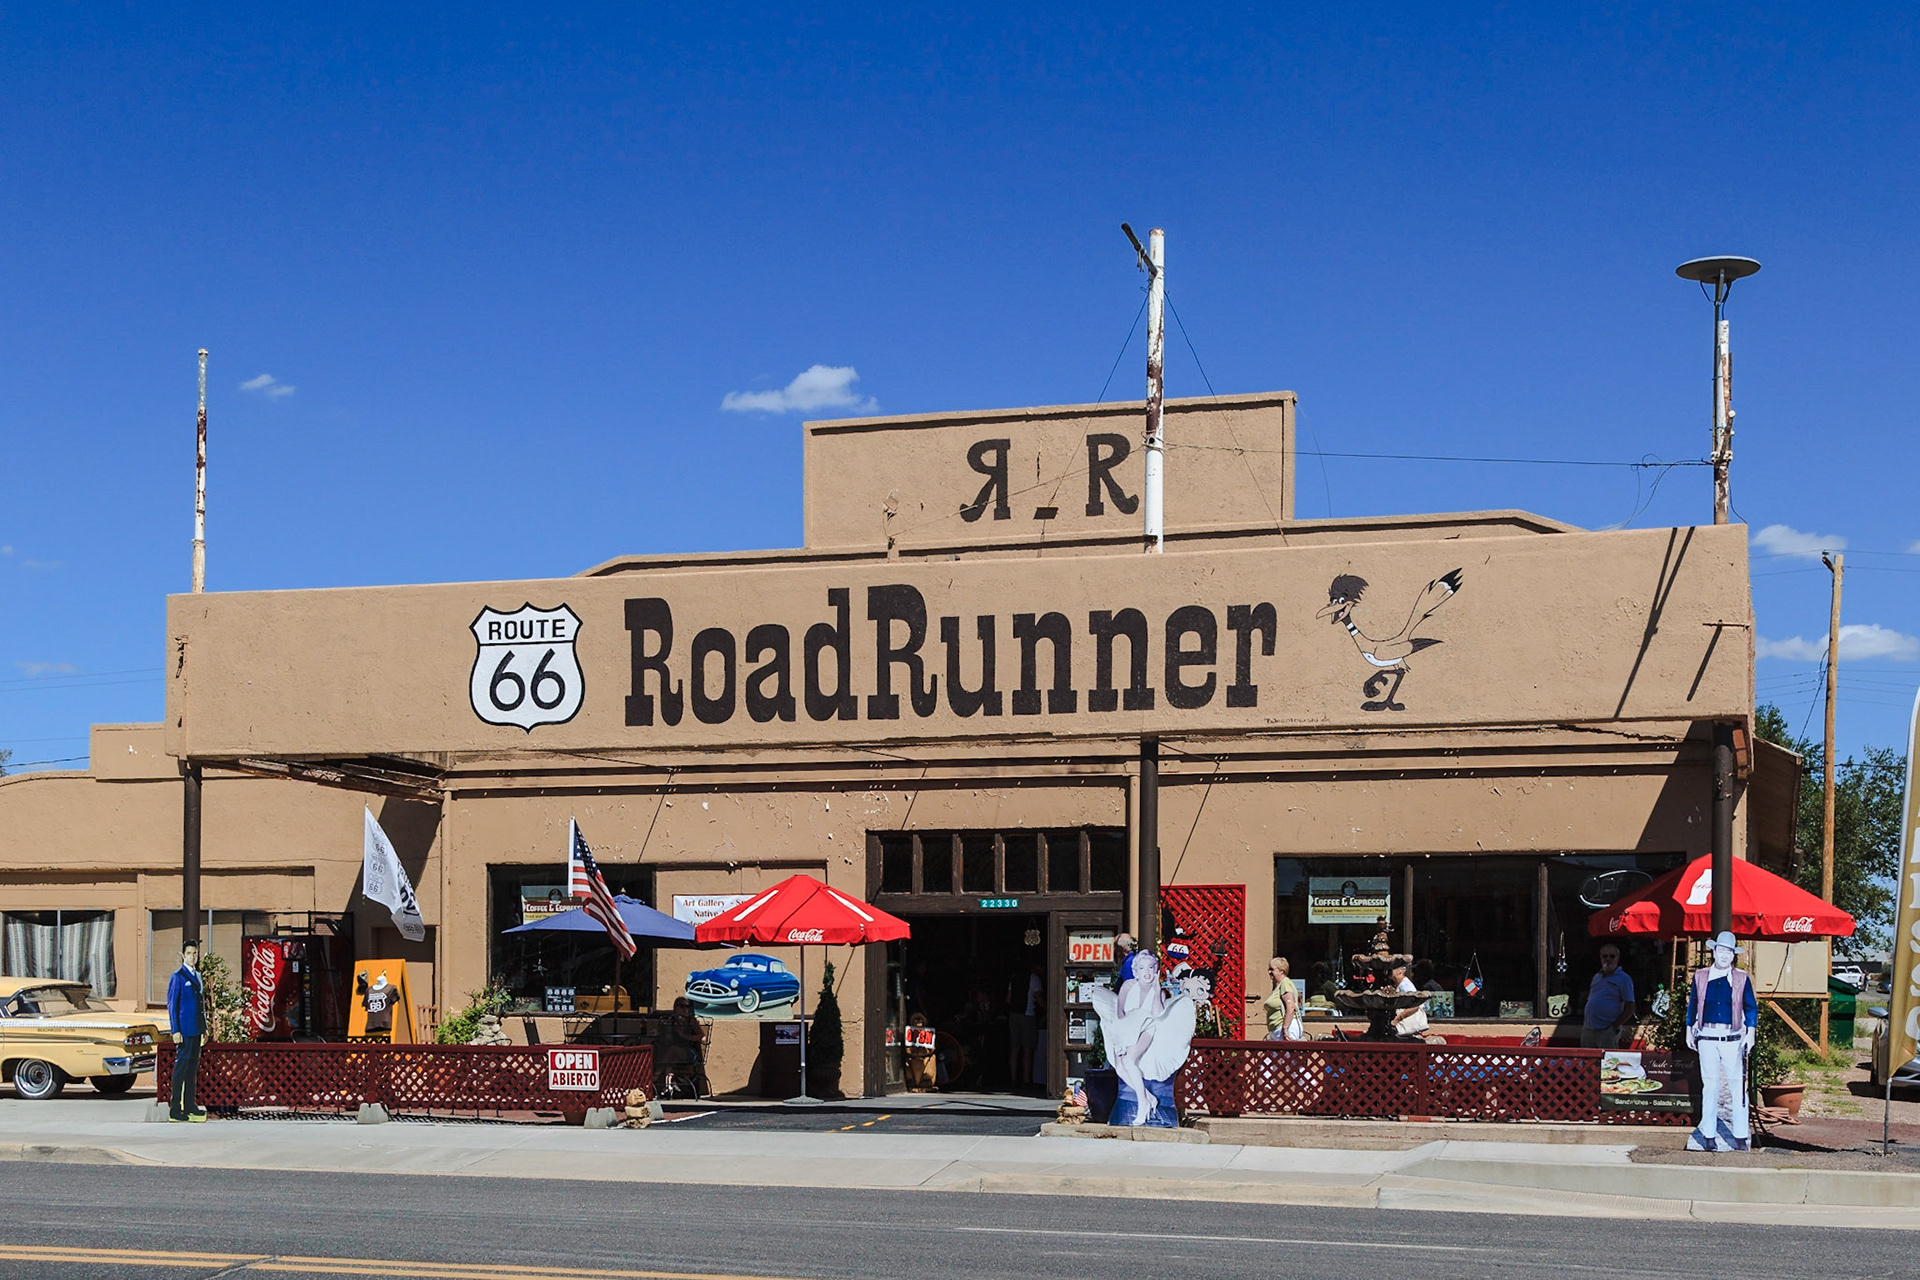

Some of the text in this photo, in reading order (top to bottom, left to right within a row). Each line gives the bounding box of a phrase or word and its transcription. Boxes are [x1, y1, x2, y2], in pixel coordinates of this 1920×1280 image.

[1085, 433, 1139, 517] R
[488, 618, 566, 641] ROUTE
[624, 584, 1277, 727] RoadRunner
[489, 648, 567, 712] 66
[372, 862, 384, 873] 66
[368, 884, 379, 893] 66
[683, 899, 696, 907] Art
[697, 899, 726, 908] Gallery
[982, 899, 1018, 908] 22330
[1314, 897, 1340, 906] COFFEE
[1349, 897, 1385, 906] ESPRESSO
[694, 909, 719, 918] Native
[1783, 916, 1816, 933] Coca-Cola
[788, 928, 825, 942] Coca-Cola
[1072, 943, 1112, 961] OPEN
[251, 943, 276, 1032] Coca-Cola
[1551, 1003, 1569, 1016] 66
[555, 1052, 593, 1070] OPEN
[552, 1072, 597, 1087] ABIERTO
[1614, 1098, 1649, 1106] Sandwiches
[1652, 1099, 1673, 1107] Salads
